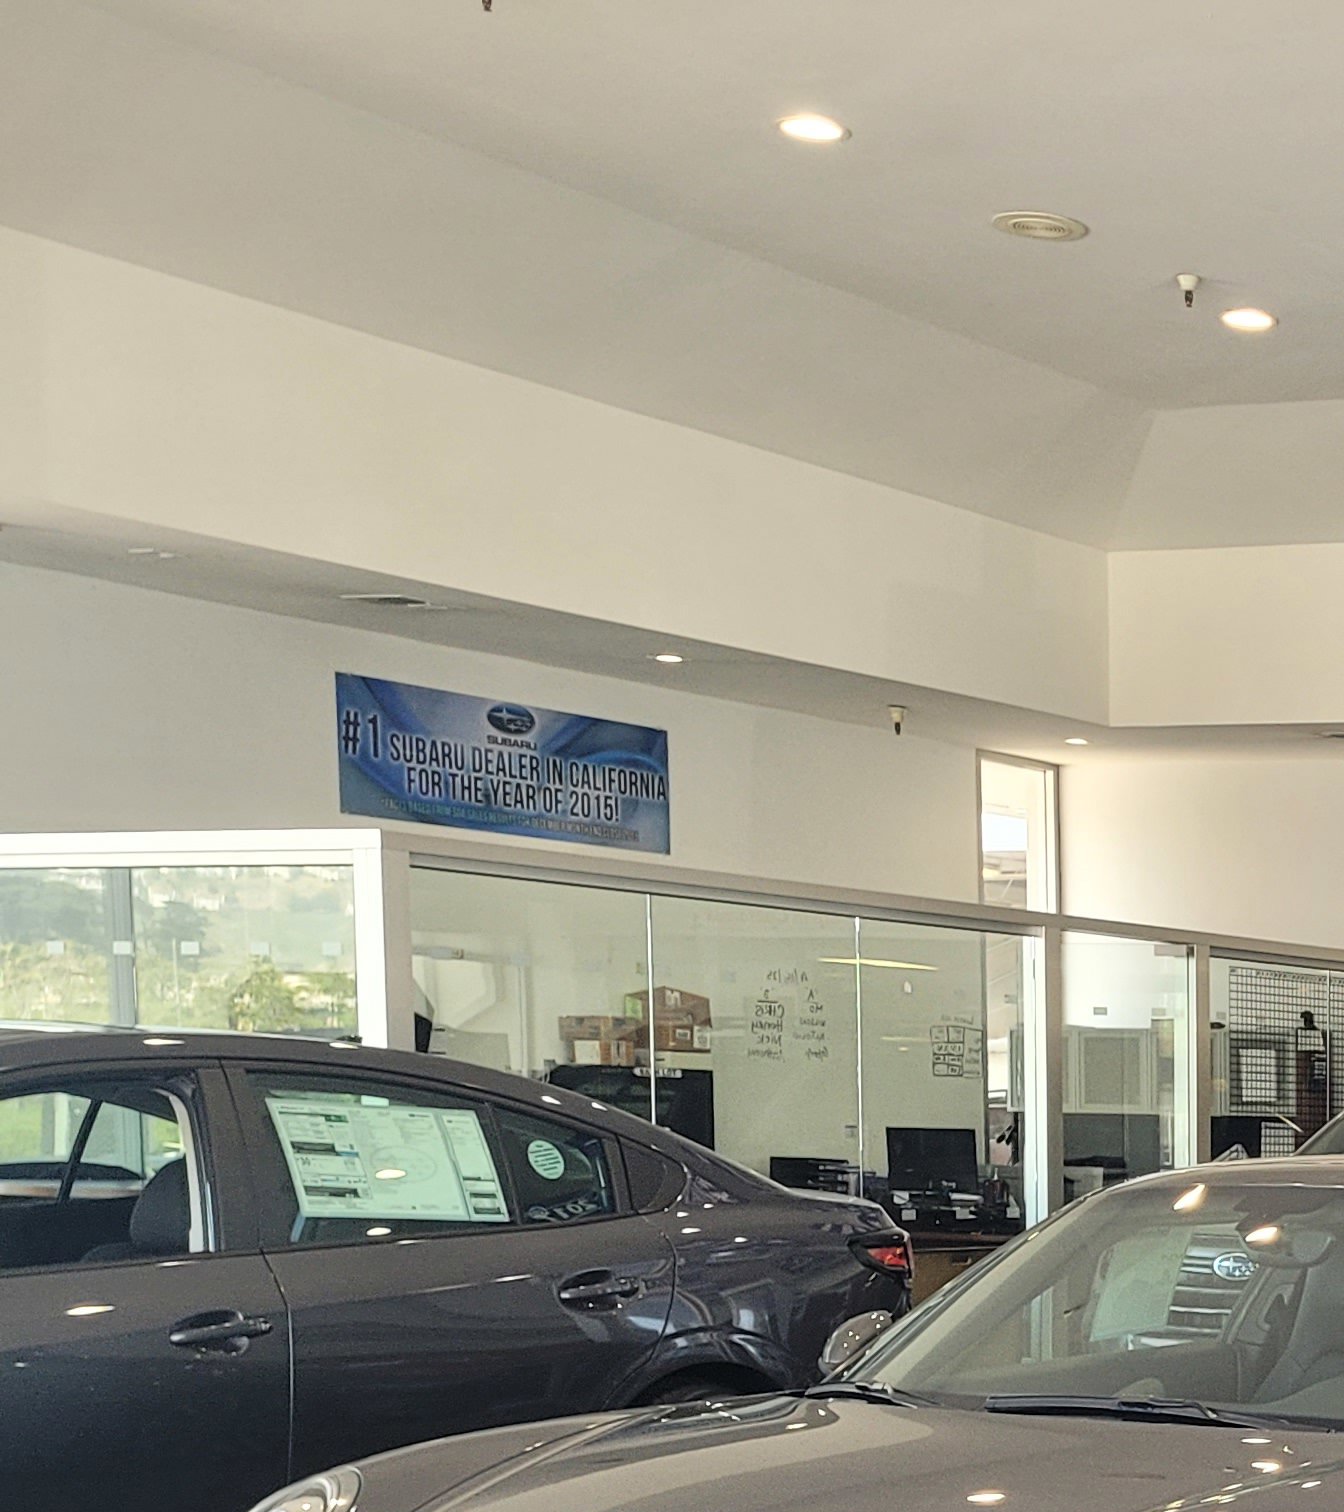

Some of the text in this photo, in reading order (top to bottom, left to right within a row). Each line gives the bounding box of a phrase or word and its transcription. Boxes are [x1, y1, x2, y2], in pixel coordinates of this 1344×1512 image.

[390, 734, 667, 801] SUBARU DEALER IN CALIFORNIA
[487, 734, 537, 750] SUBARU
[407, 767, 443, 799] FOR
[449, 773, 484, 805] THE
[490, 780, 537, 812] YEAR
[543, 788, 563, 815] OF
[570, 790, 619, 822] 2015!
